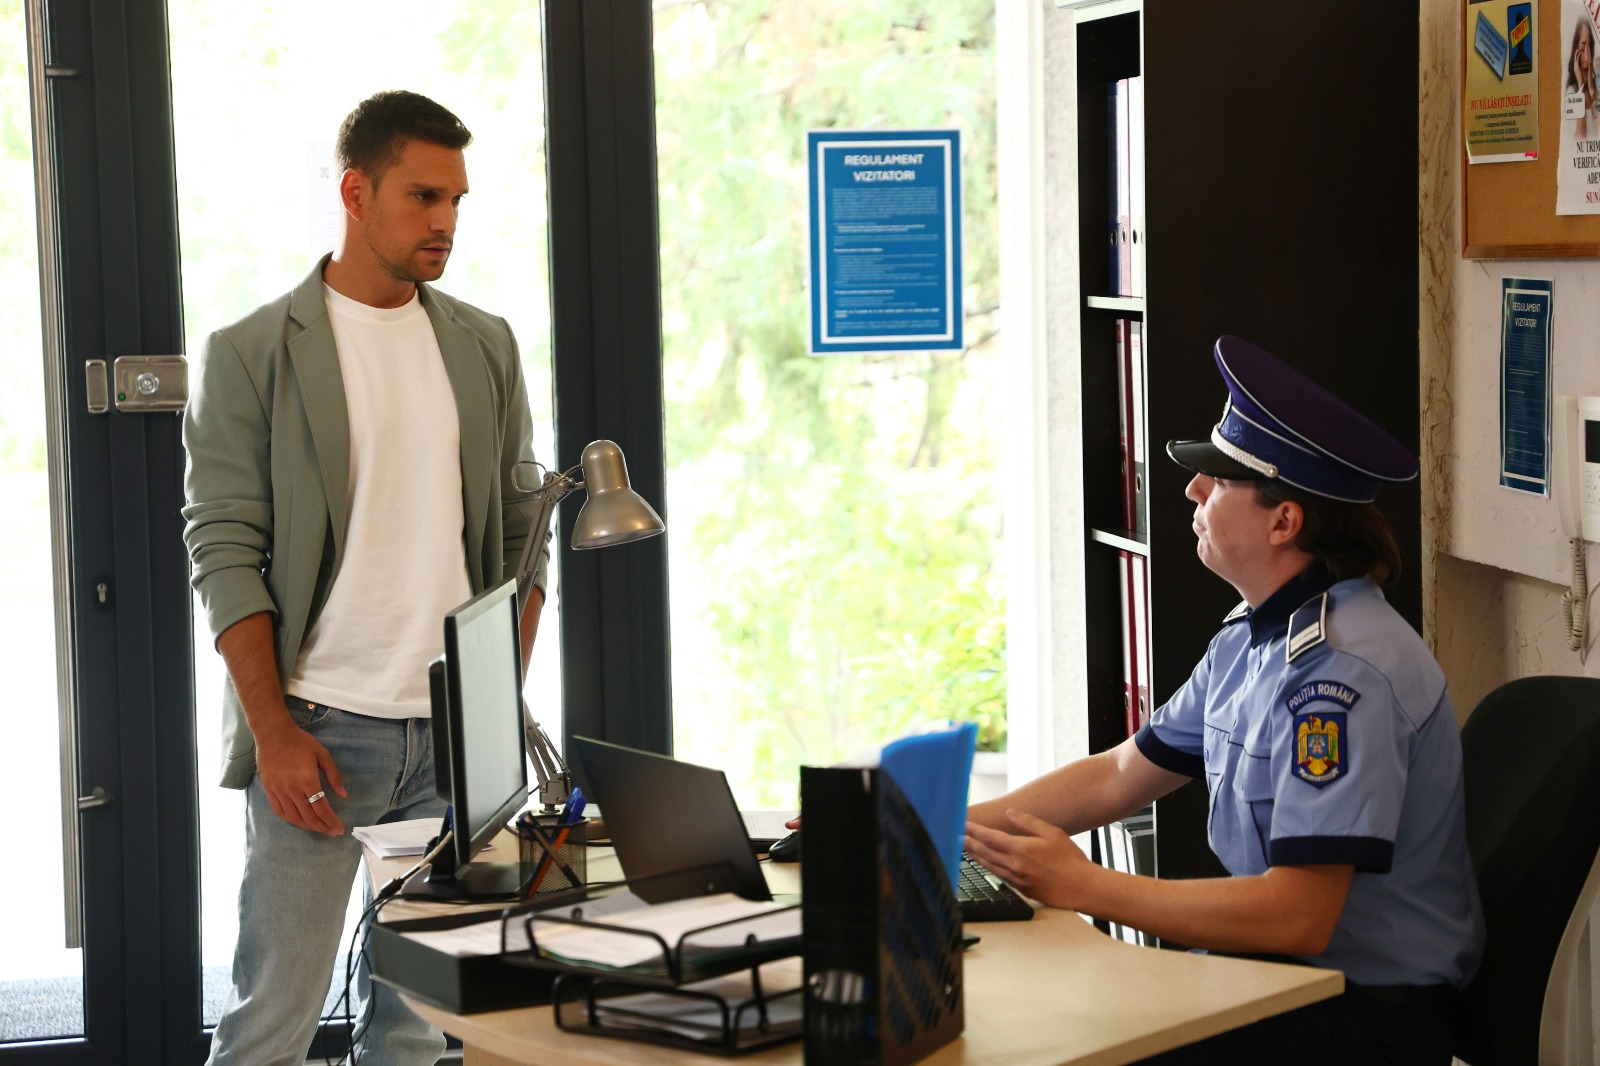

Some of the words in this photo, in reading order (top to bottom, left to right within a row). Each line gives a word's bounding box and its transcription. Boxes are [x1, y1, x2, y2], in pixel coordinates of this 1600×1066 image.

[1576, 141, 1585, 153] NU
[844, 153, 924, 166] REGULAMENT
[853, 169, 916, 182] VIZITATORI
[1585, 191, 1600, 204] SUN
[1512, 301, 1541, 313] REGULAMENT
[1514, 317, 1538, 328] VIZITATORI
